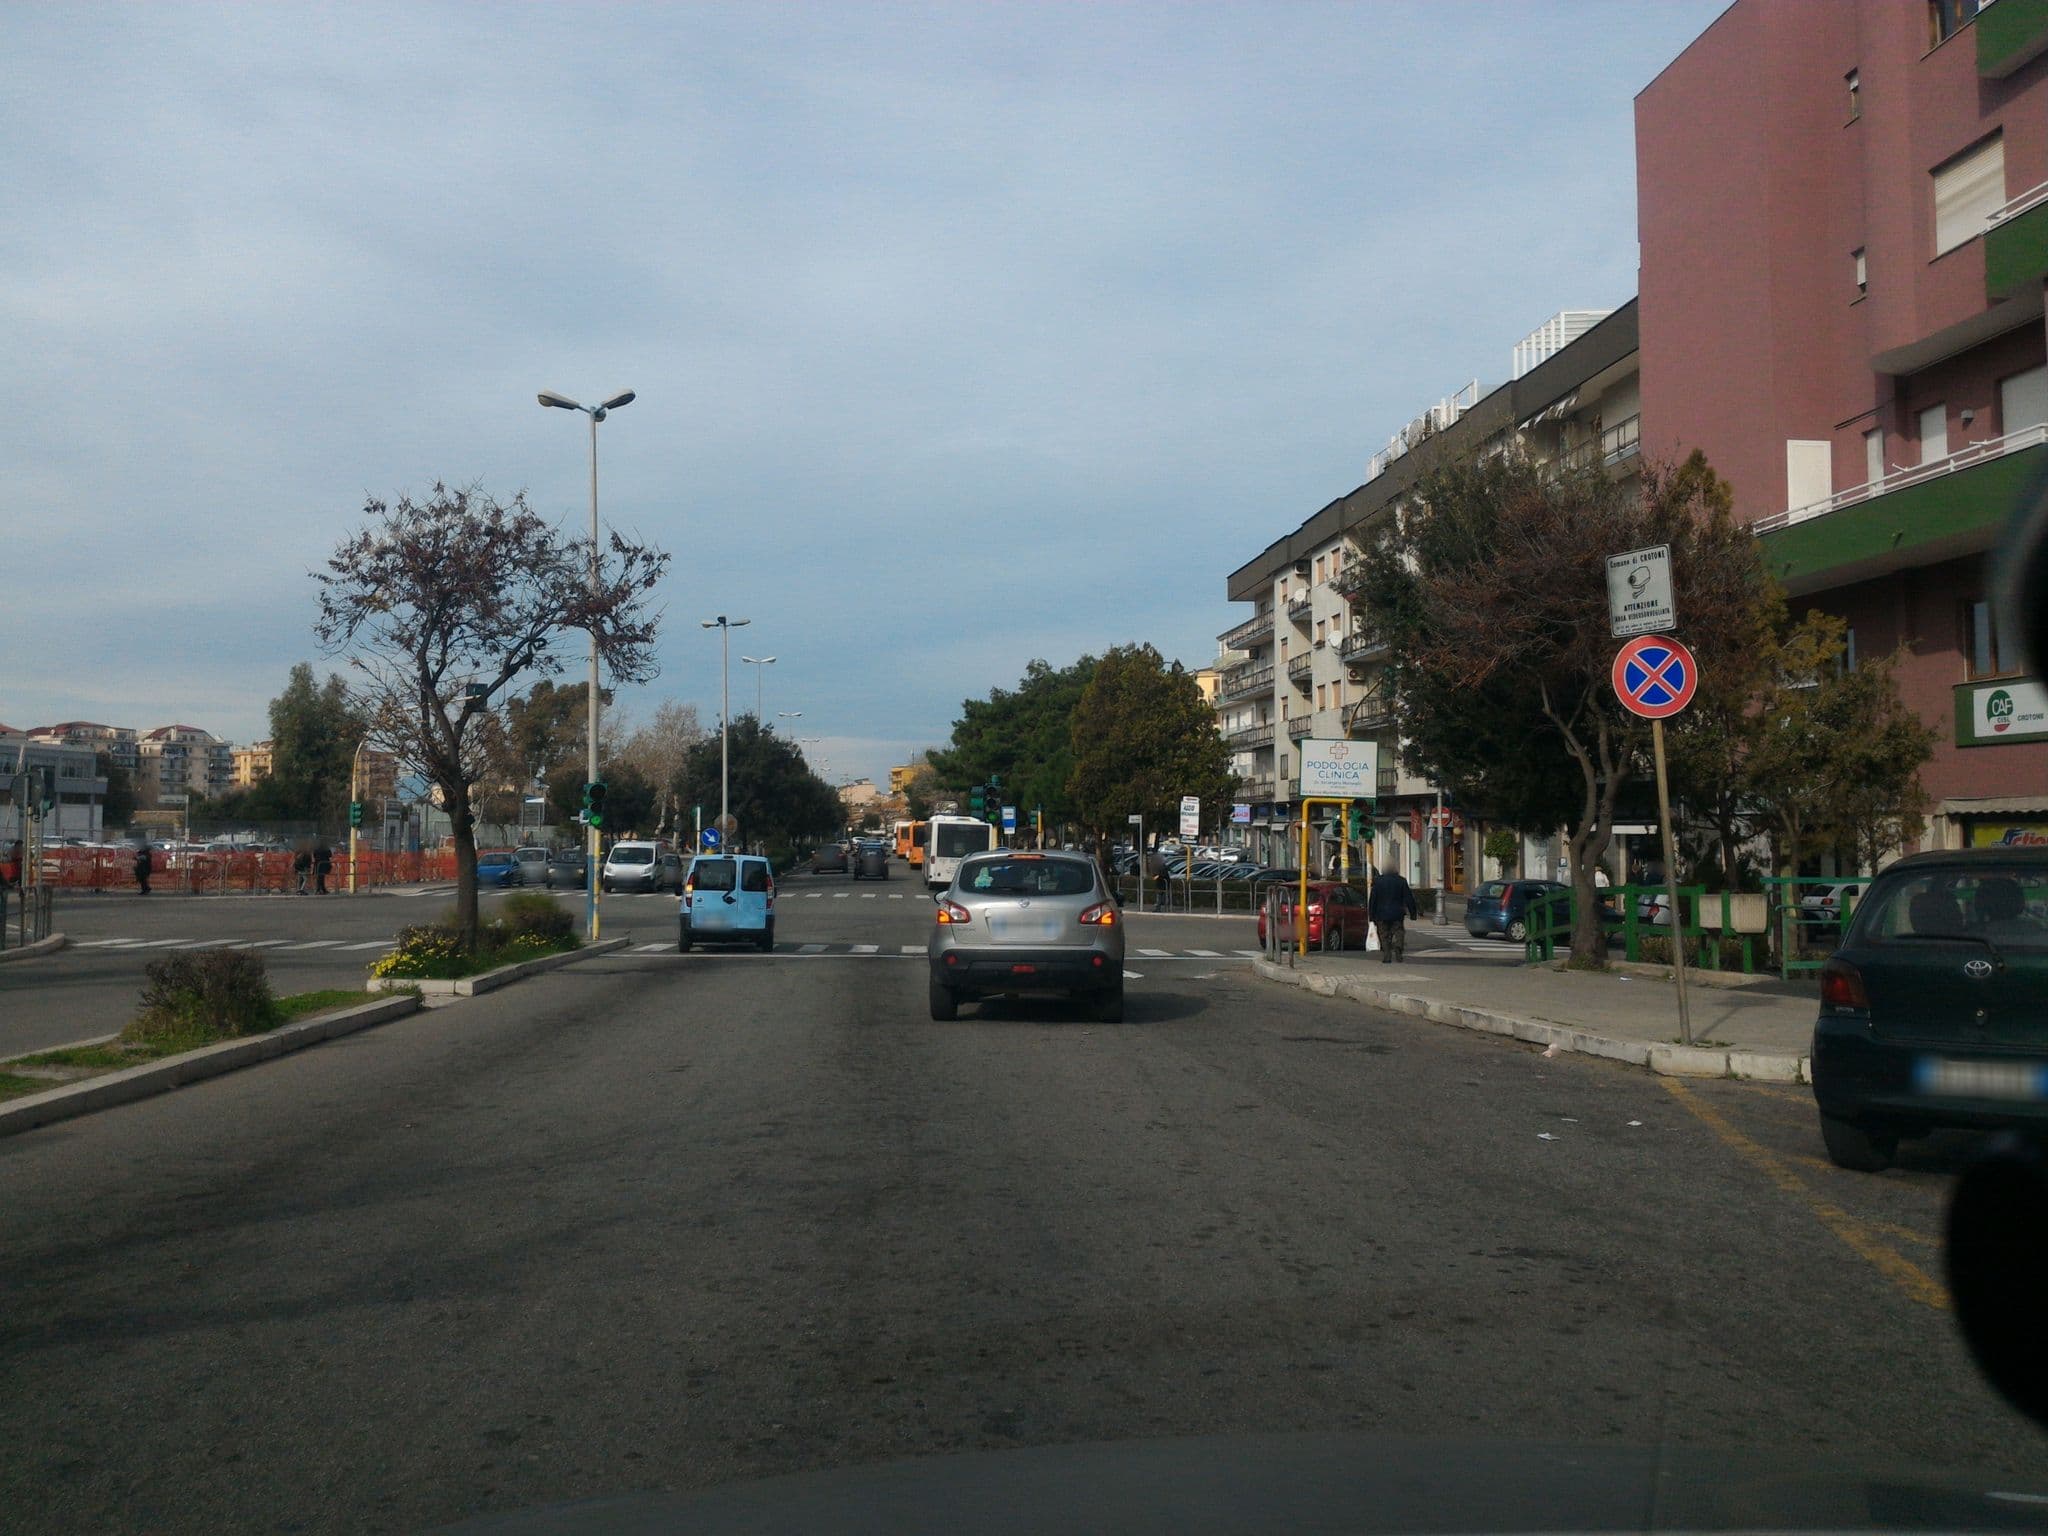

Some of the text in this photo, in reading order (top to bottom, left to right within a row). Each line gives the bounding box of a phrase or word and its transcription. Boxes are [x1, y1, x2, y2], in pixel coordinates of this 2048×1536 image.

[1610, 560, 1630, 568] Comune
[1640, 550, 1665, 562] CROTONE
[1624, 600, 1658, 611] ATTENZIONE
[1992, 698, 2012, 715] CAF
[2017, 713, 2044, 721] CROTONE
[1307, 761, 1369, 770] PODOLOGIA
[1318, 770, 1359, 779] CLINICA
